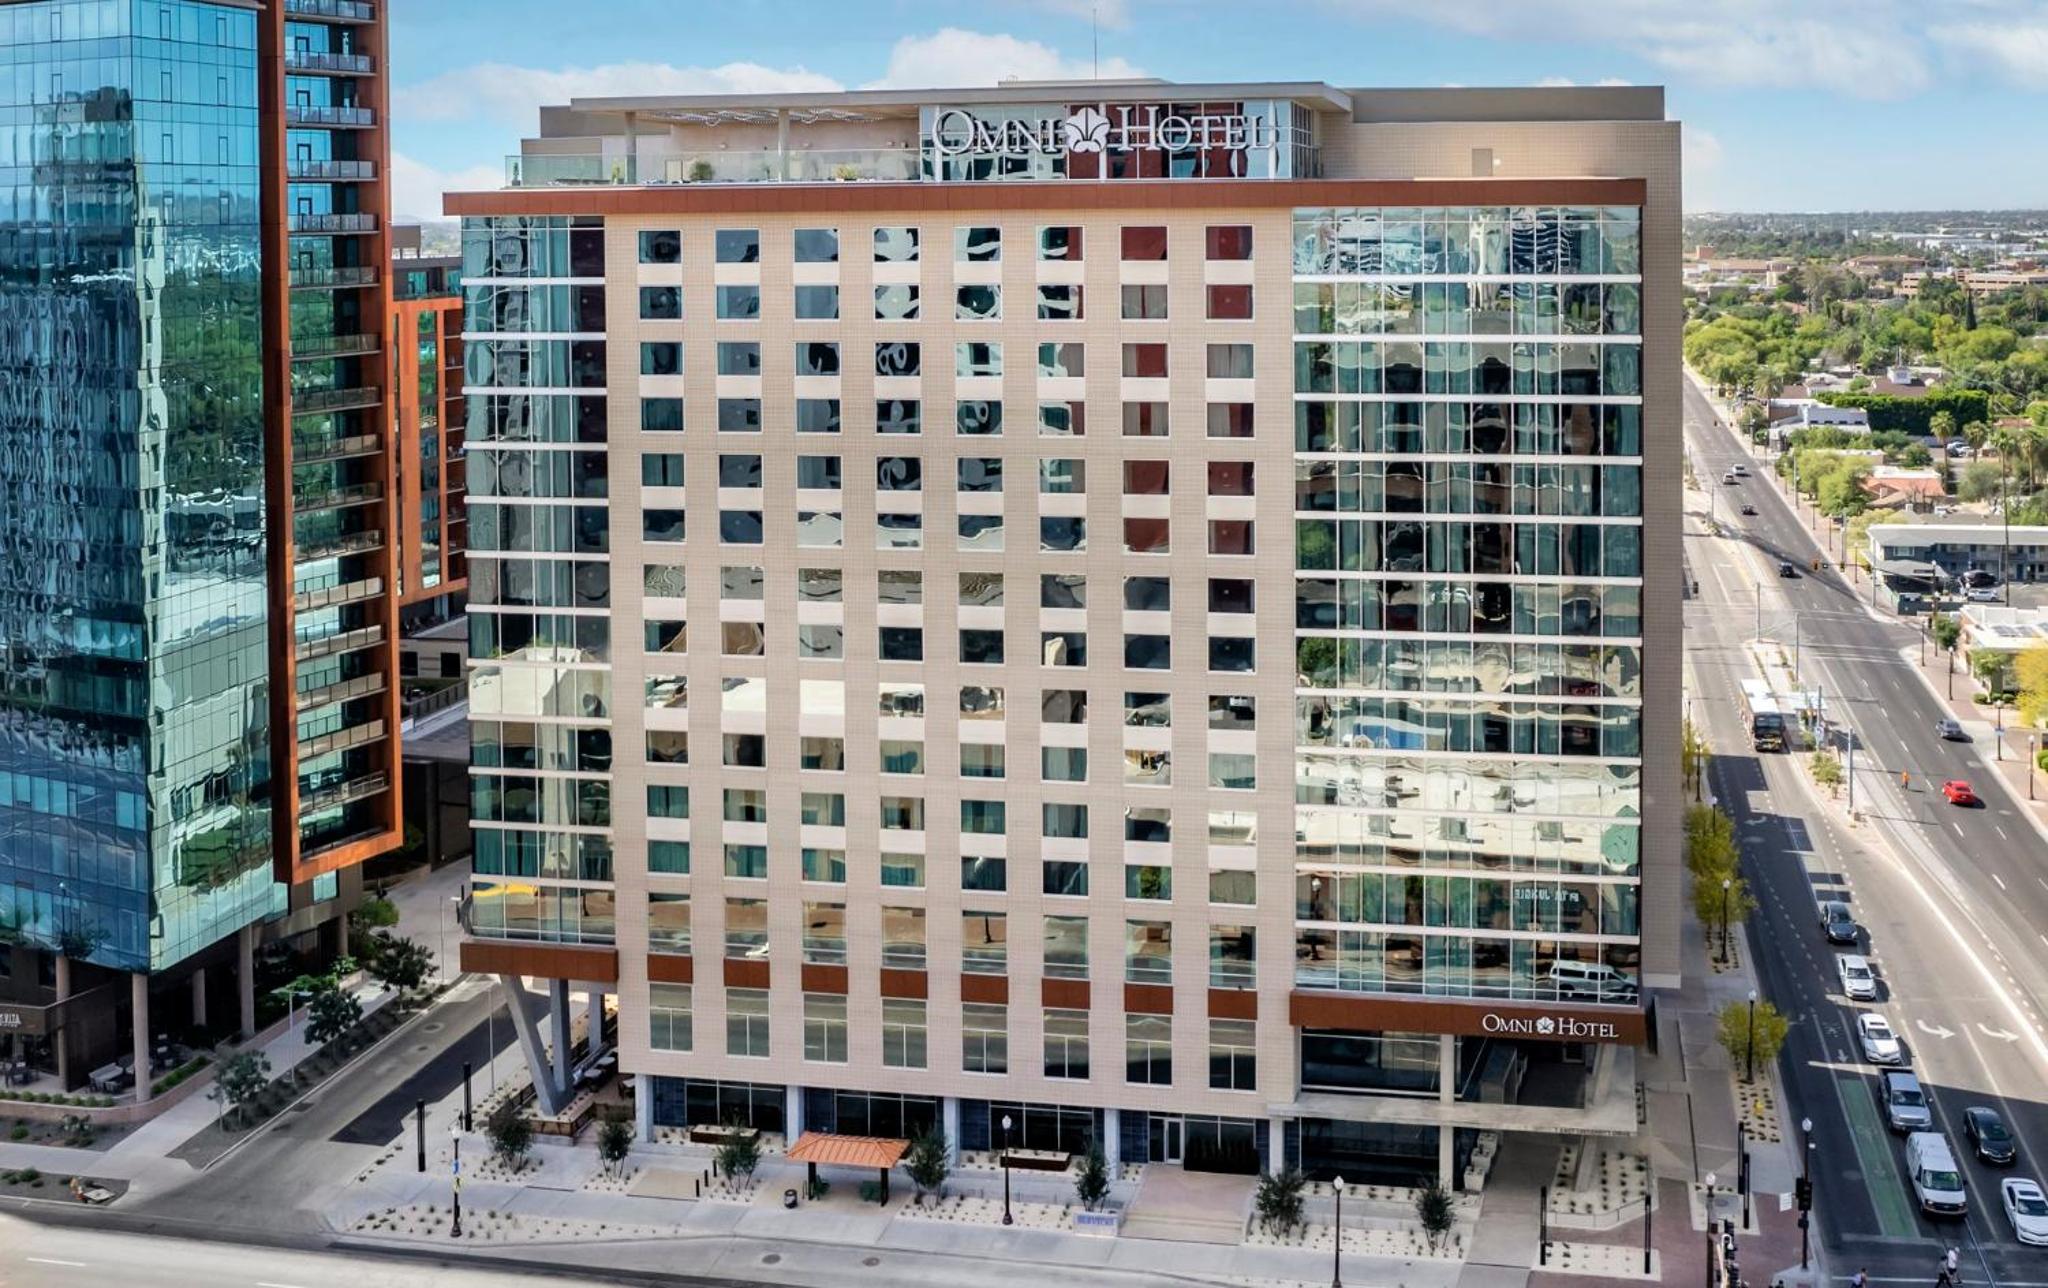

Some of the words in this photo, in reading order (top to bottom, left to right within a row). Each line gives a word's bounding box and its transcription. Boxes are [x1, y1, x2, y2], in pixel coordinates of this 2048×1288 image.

[933, 110, 1058, 154] OMNI
[1117, 106, 1274, 151] HOTEL
[1482, 1014, 1533, 1033] OMNI
[1558, 1017, 1619, 1038] HOTEL
